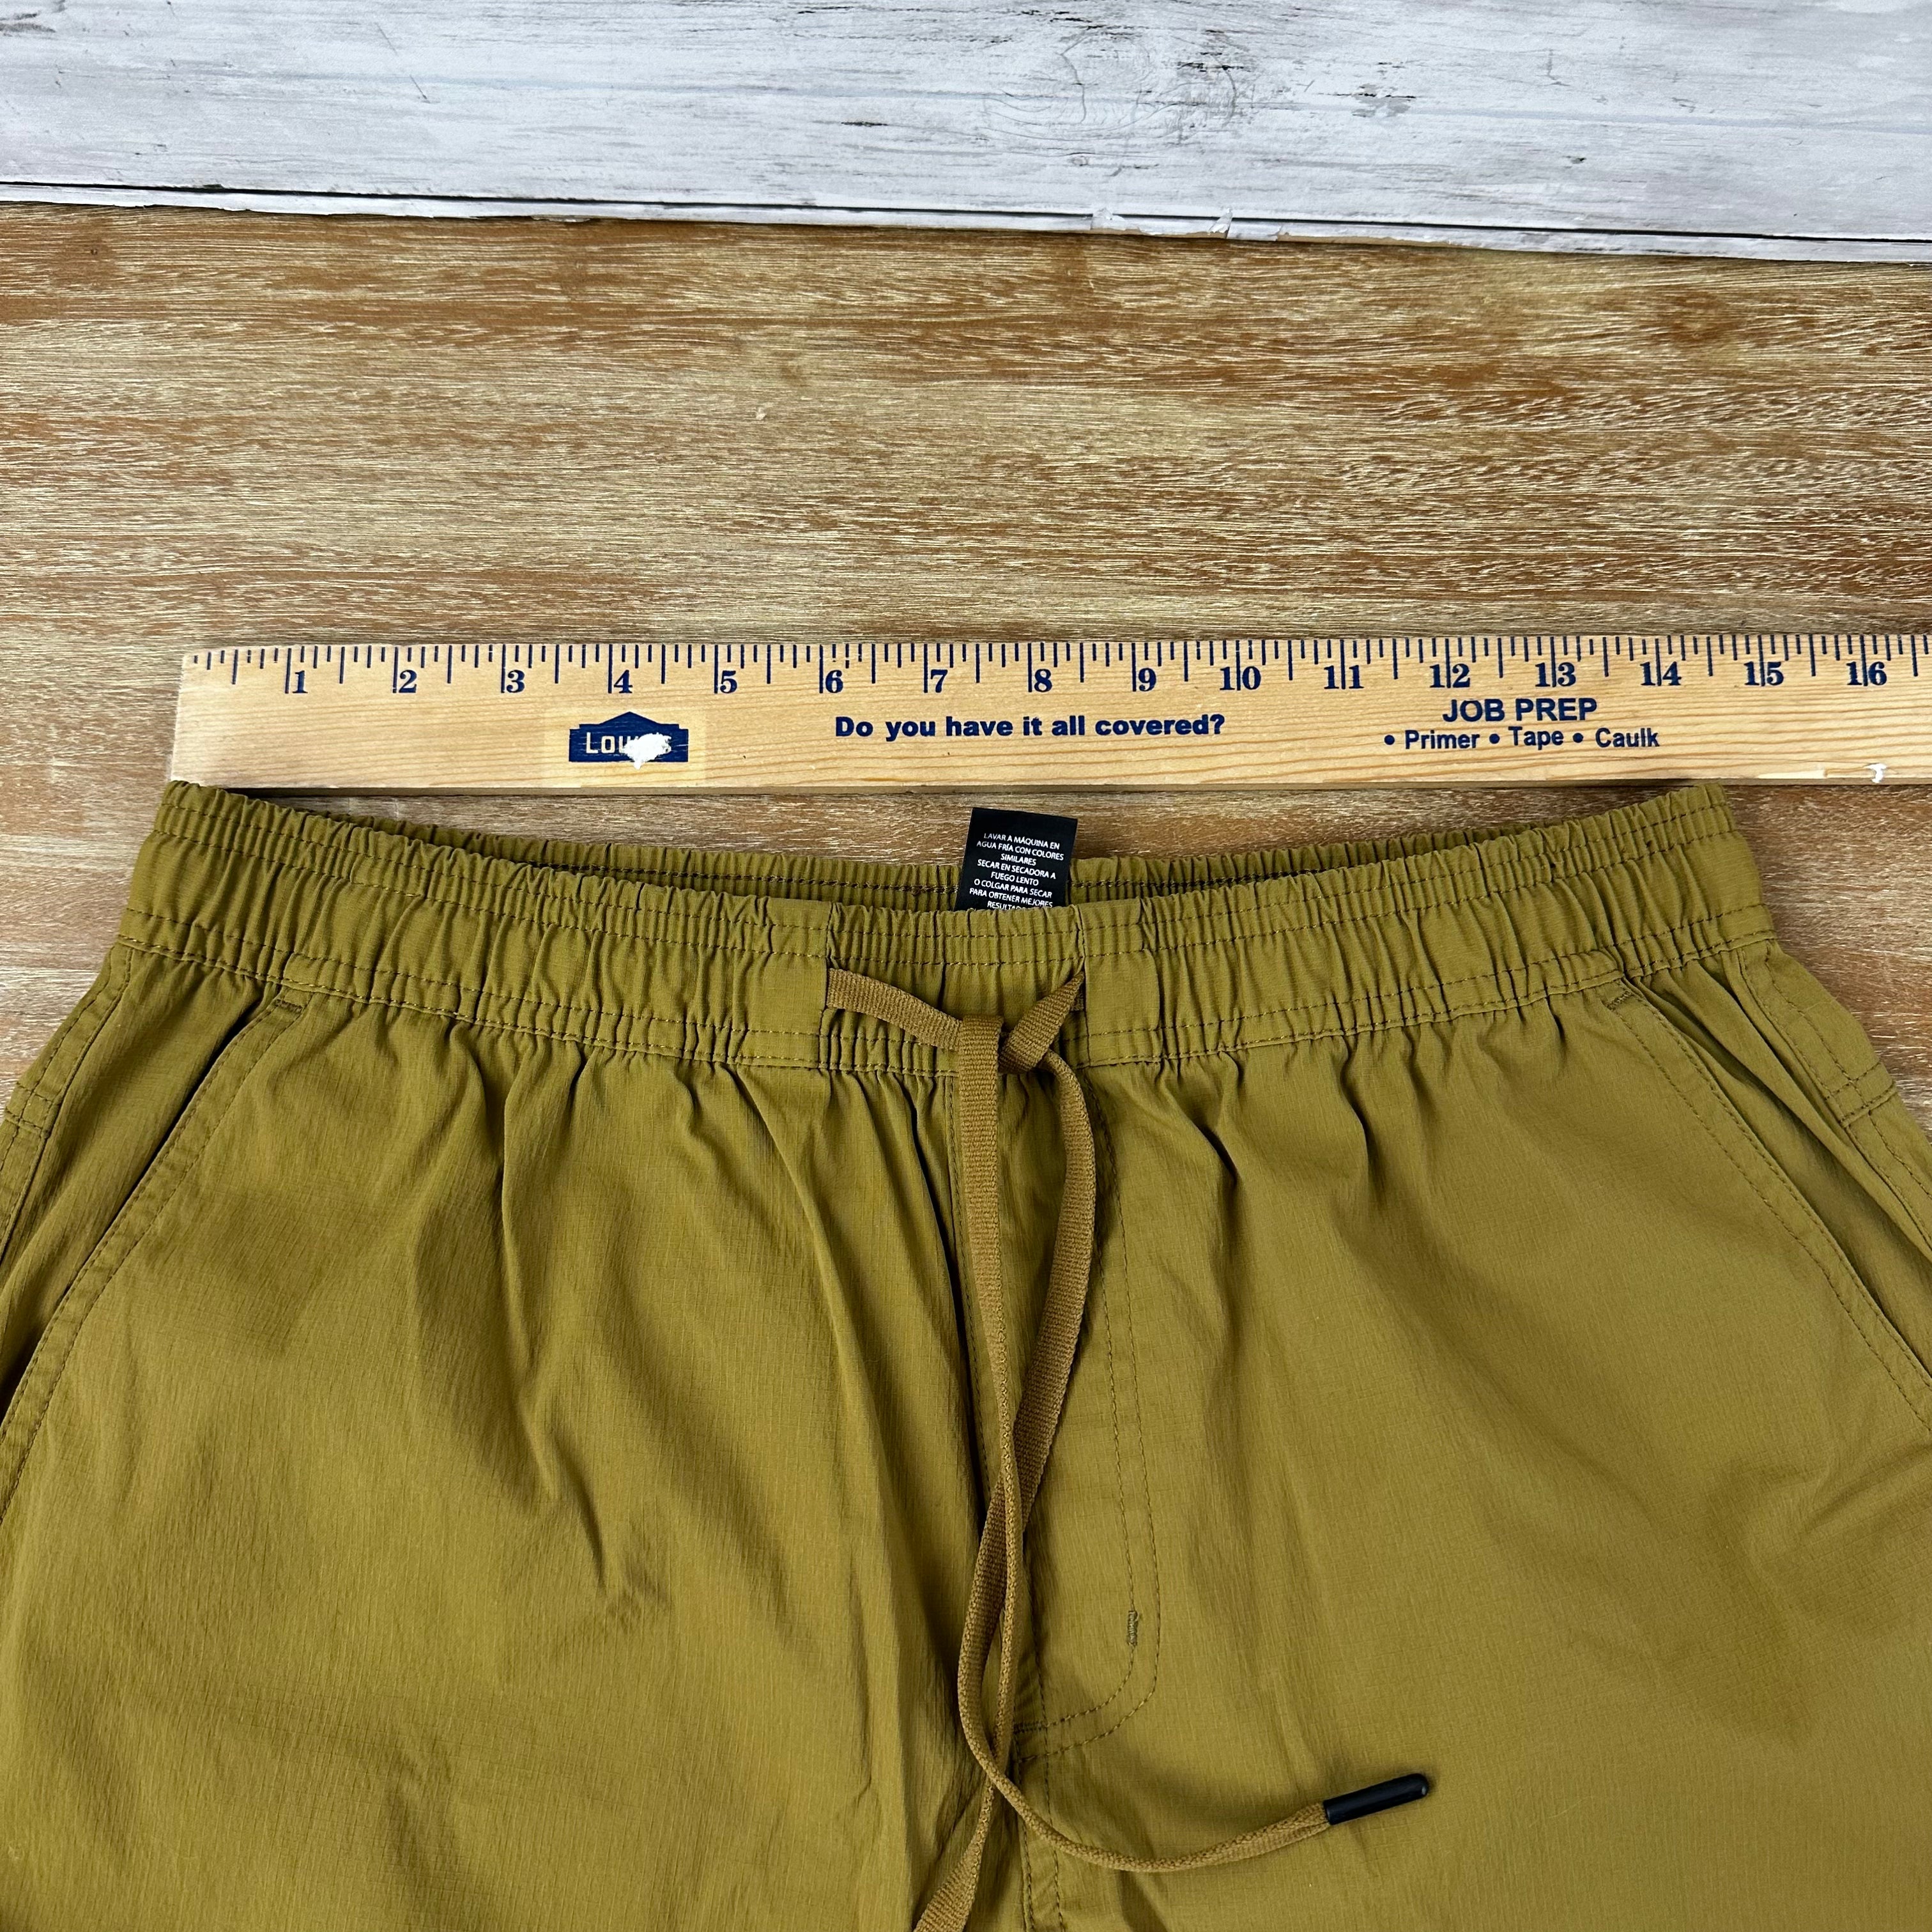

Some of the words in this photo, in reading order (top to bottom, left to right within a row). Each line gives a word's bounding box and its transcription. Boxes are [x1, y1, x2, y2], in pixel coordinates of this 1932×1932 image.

[293, 671, 307, 694] 1
[399, 670, 417, 693] 2
[506, 670, 525, 693] 3
[614, 670, 632, 694] 4
[719, 670, 737, 693] 5
[825, 670, 843, 693] 6
[930, 669, 948, 693] 7
[1034, 669, 1052, 692] 8
[1138, 668, 1156, 691] 9
[1220, 666, 1261, 691] 10
[1324, 665, 1363, 689] 11
[1430, 664, 1470, 688] 12
[1535, 663, 1577, 687] 13
[1640, 661, 1682, 686] 14
[1744, 661, 1784, 686] 15
[1846, 661, 1887, 686] 16
[1442, 698, 1505, 723] JOB
[1515, 697, 1597, 721] PREP
[836, 716, 873, 737] Do
[885, 721, 936, 742] you
[946, 716, 1013, 737] have
[1023, 716, 1042, 736] it
[1052, 715, 1085, 736] all
[1095, 714, 1225, 735] covered?
[1405, 729, 1480, 749] Primer
[1508, 726, 1564, 750] Tape
[1596, 727, 1660, 748] Caulk
[976, 841, 997, 849] AGUA
[998, 843, 1014, 852] FRÍA
[1015, 846, 1031, 855] CON
[1032, 848, 1064, 861] COLORES
[983, 832, 1006, 841] LAVAR
[1013, 836, 1048, 847] MÁQUINA
[1050, 841, 1060, 850] EN
[977, 859, 1000, 869] SECAR
[1011, 865, 1049, 878] SECADORA
[1000, 853, 1037, 866] SIMILARES
[990, 871, 1015, 882] FUEGO
[1016, 876, 1039, 886] LENTO
[969, 887, 987, 897] PARA
[988, 891, 1020, 903] OBTENER
[1020, 896, 1053, 908] MEJORES
[981, 880, 1009, 891] COLGAR
[1010, 885, 1028, 894] PARA
[1029, 888, 1052, 898] SECAR
